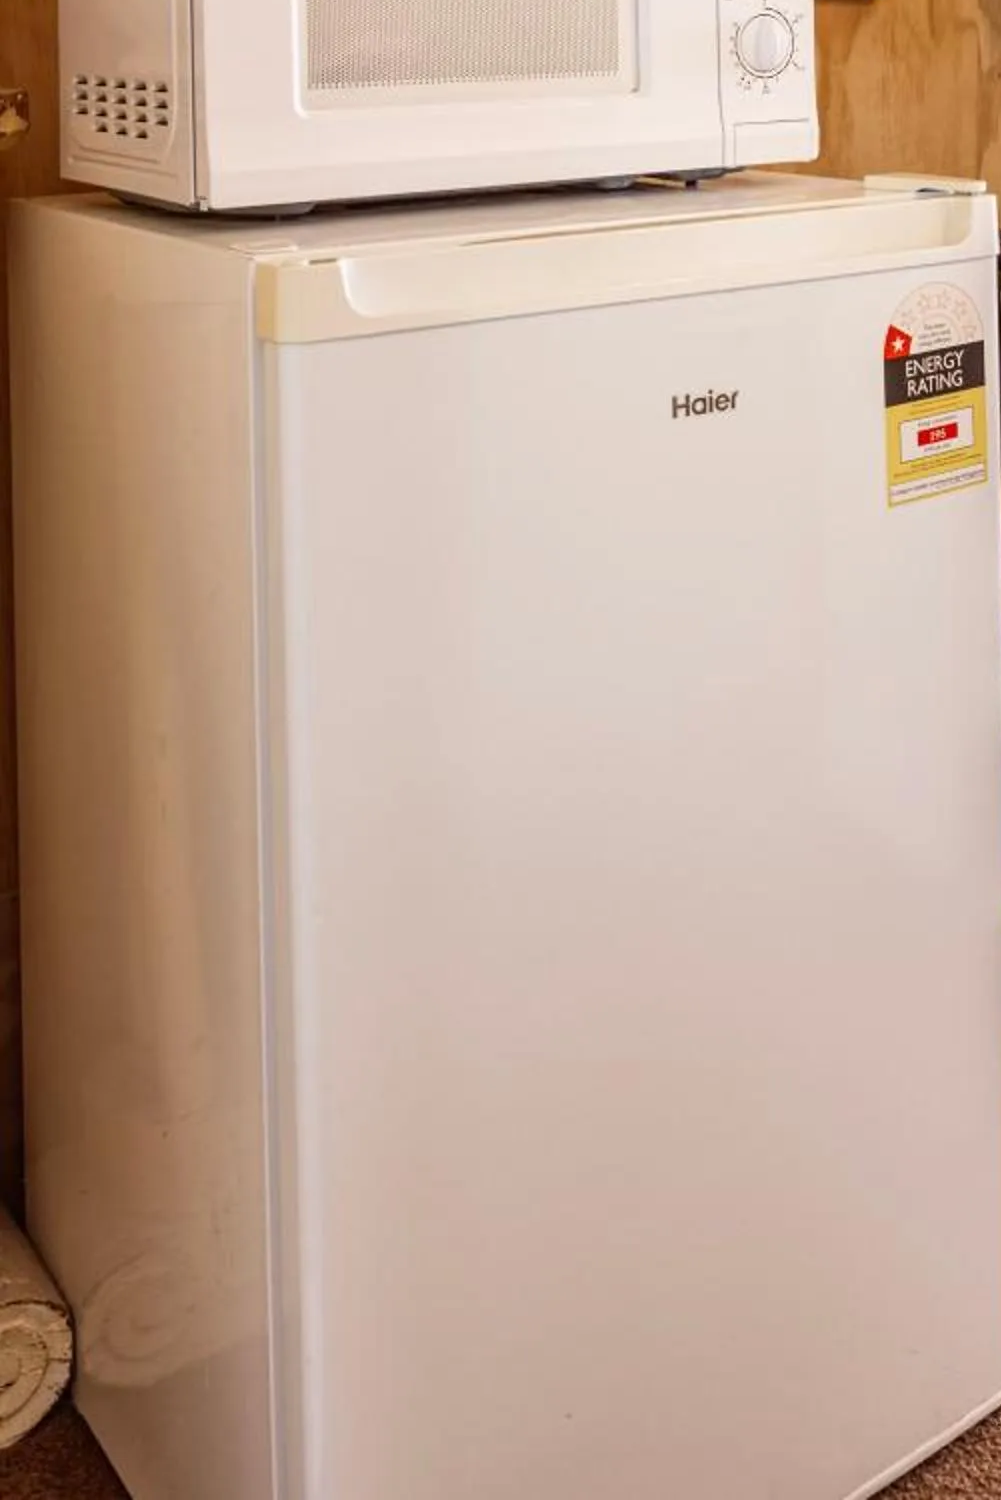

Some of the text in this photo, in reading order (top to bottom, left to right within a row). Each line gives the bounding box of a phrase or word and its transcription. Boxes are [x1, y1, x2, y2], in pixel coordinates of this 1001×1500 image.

[905, 350, 965, 378] ENERGY
[907, 369, 963, 397] RATING
[671, 389, 739, 419] Haier
